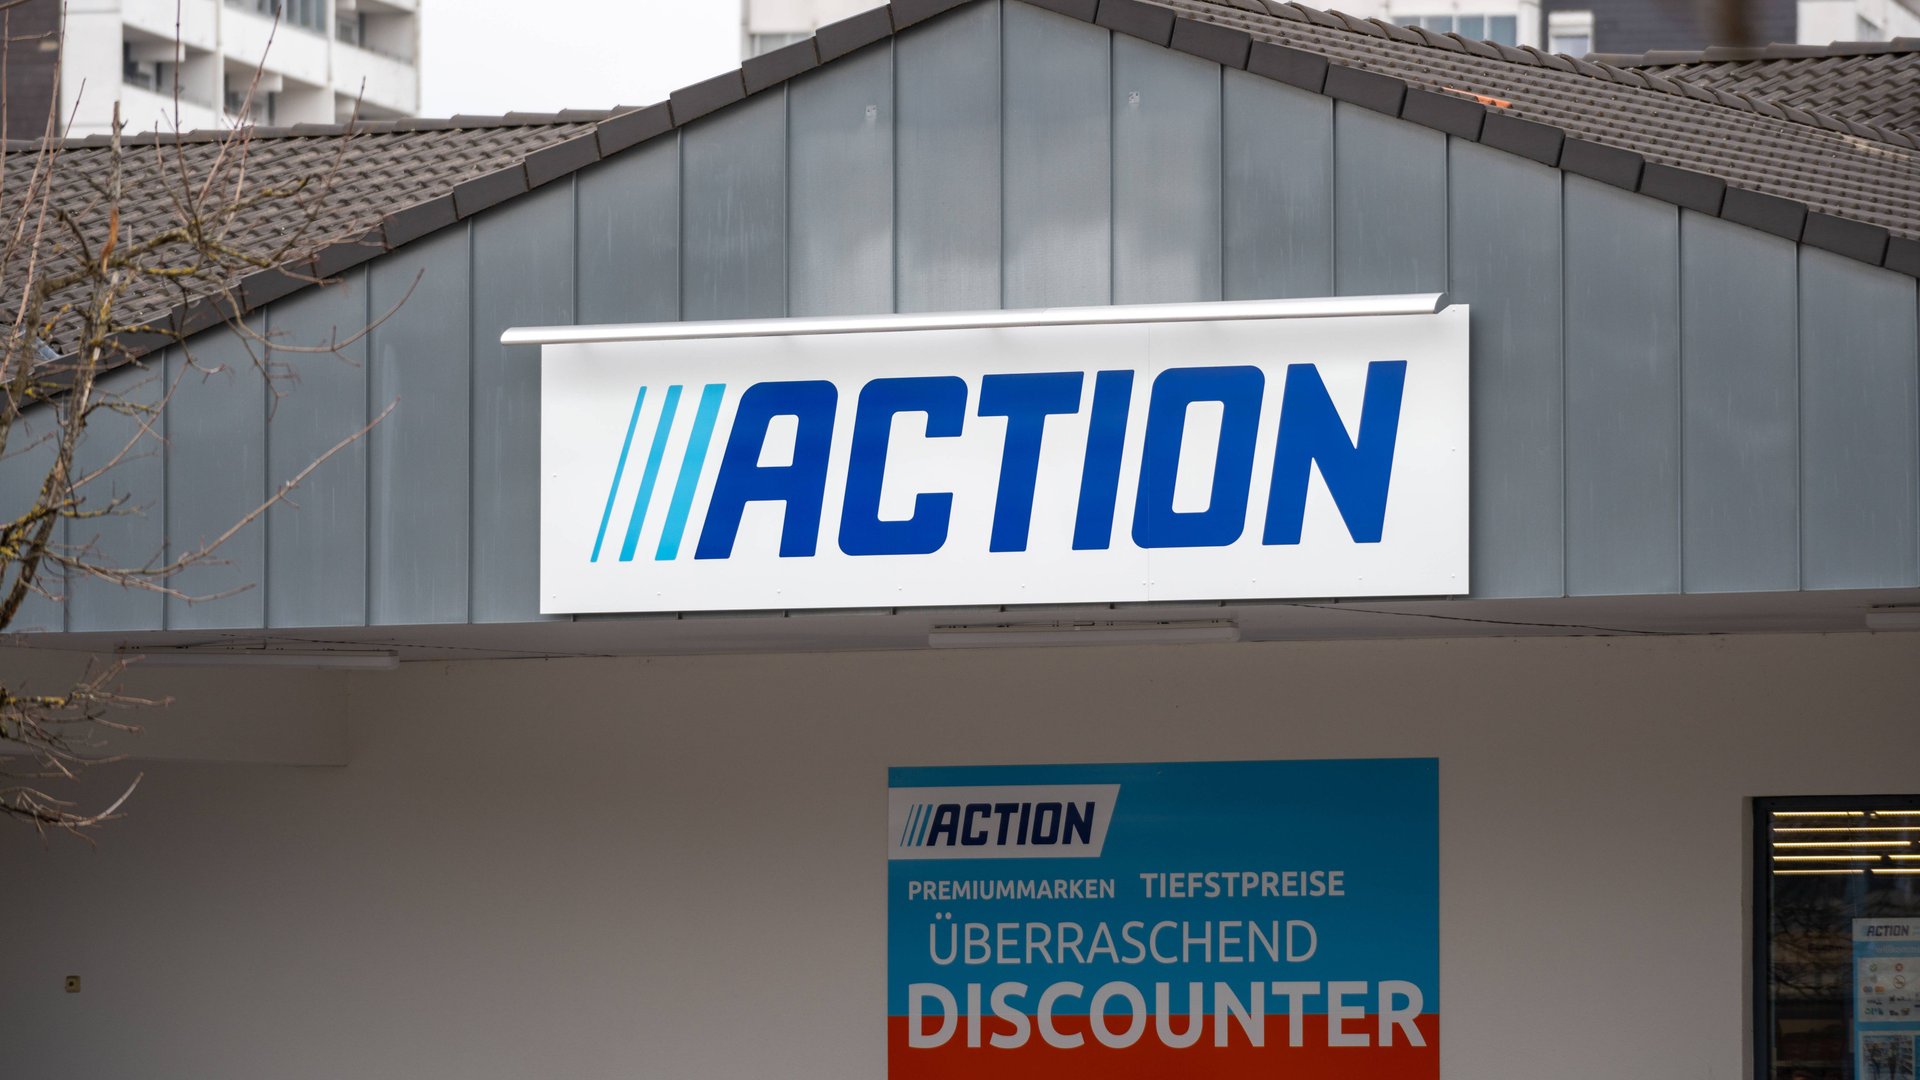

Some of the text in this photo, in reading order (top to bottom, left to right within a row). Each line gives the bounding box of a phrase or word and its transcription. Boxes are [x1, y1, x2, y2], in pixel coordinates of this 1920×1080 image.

[695, 360, 1407, 560] ACTION
[927, 801, 1096, 846] ACTION
[908, 870, 1345, 900] PREMIUMMARKEN TIEFSTPREISE
[929, 912, 1318, 965] ÜBERRASCHEND
[1866, 925, 1909, 937] ACTION
[908, 980, 1428, 1049] DISCOUNTER
